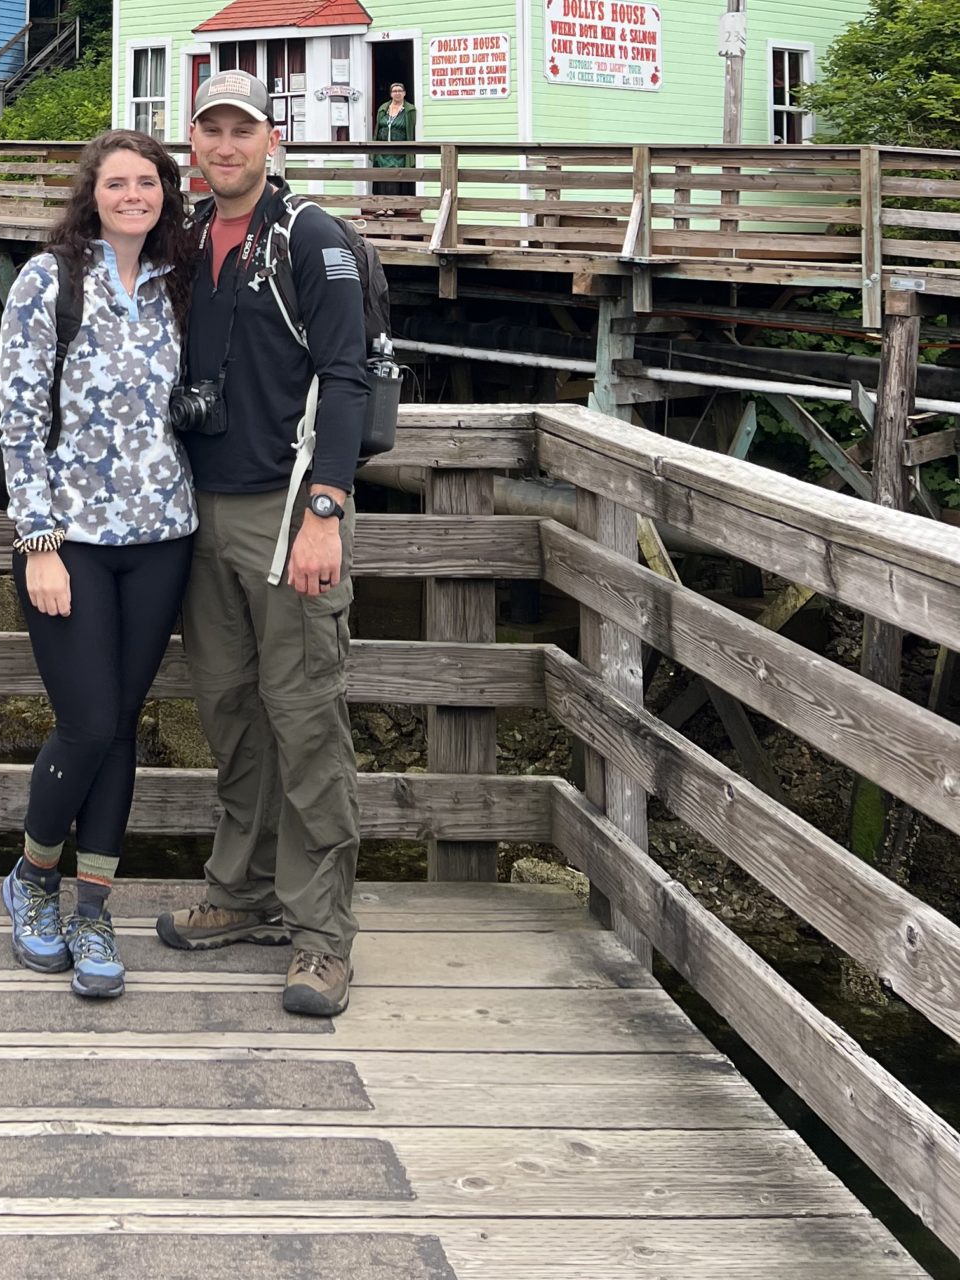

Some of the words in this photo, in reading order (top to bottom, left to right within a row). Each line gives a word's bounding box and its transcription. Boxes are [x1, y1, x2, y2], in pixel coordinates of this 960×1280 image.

[611, 3, 646, 25] HOUSE
[551, 20, 577, 37] WHERE
[579, 23, 598, 39] BOTH
[601, 25, 616, 41] MEN
[620, 28, 627, 42] &
[630, 29, 657, 45] SALMON
[437, 38, 468, 52] DOLLY'S
[473, 36, 500, 50] HOUSE
[551, 38, 573, 54] CAME
[576, 41, 615, 58] UPSTREAM
[619, 45, 628, 60] TO
[631, 47, 657, 62] SPAWN
[432, 55, 457, 65] HISTORIC
[459, 54, 470, 64] RED
[472, 53, 489, 63] LIGHT
[491, 52, 506, 62] TOUR
[569, 59, 592, 70] HISTORIC
[432, 68, 448, 76] WHERE
[450, 67, 463, 76] BOTH
[465, 67, 476, 75] MEN
[486, 65, 507, 74] SALMON
[432, 78, 446, 87] CAME
[448, 77, 475, 86] UPSTREAM
[478, 77, 485, 85] TO
[487, 76, 507, 85] SPAWN
[596, 73, 615, 84] STREET
[246, 233, 255, 242] R
[242, 241, 252, 260] EOS
